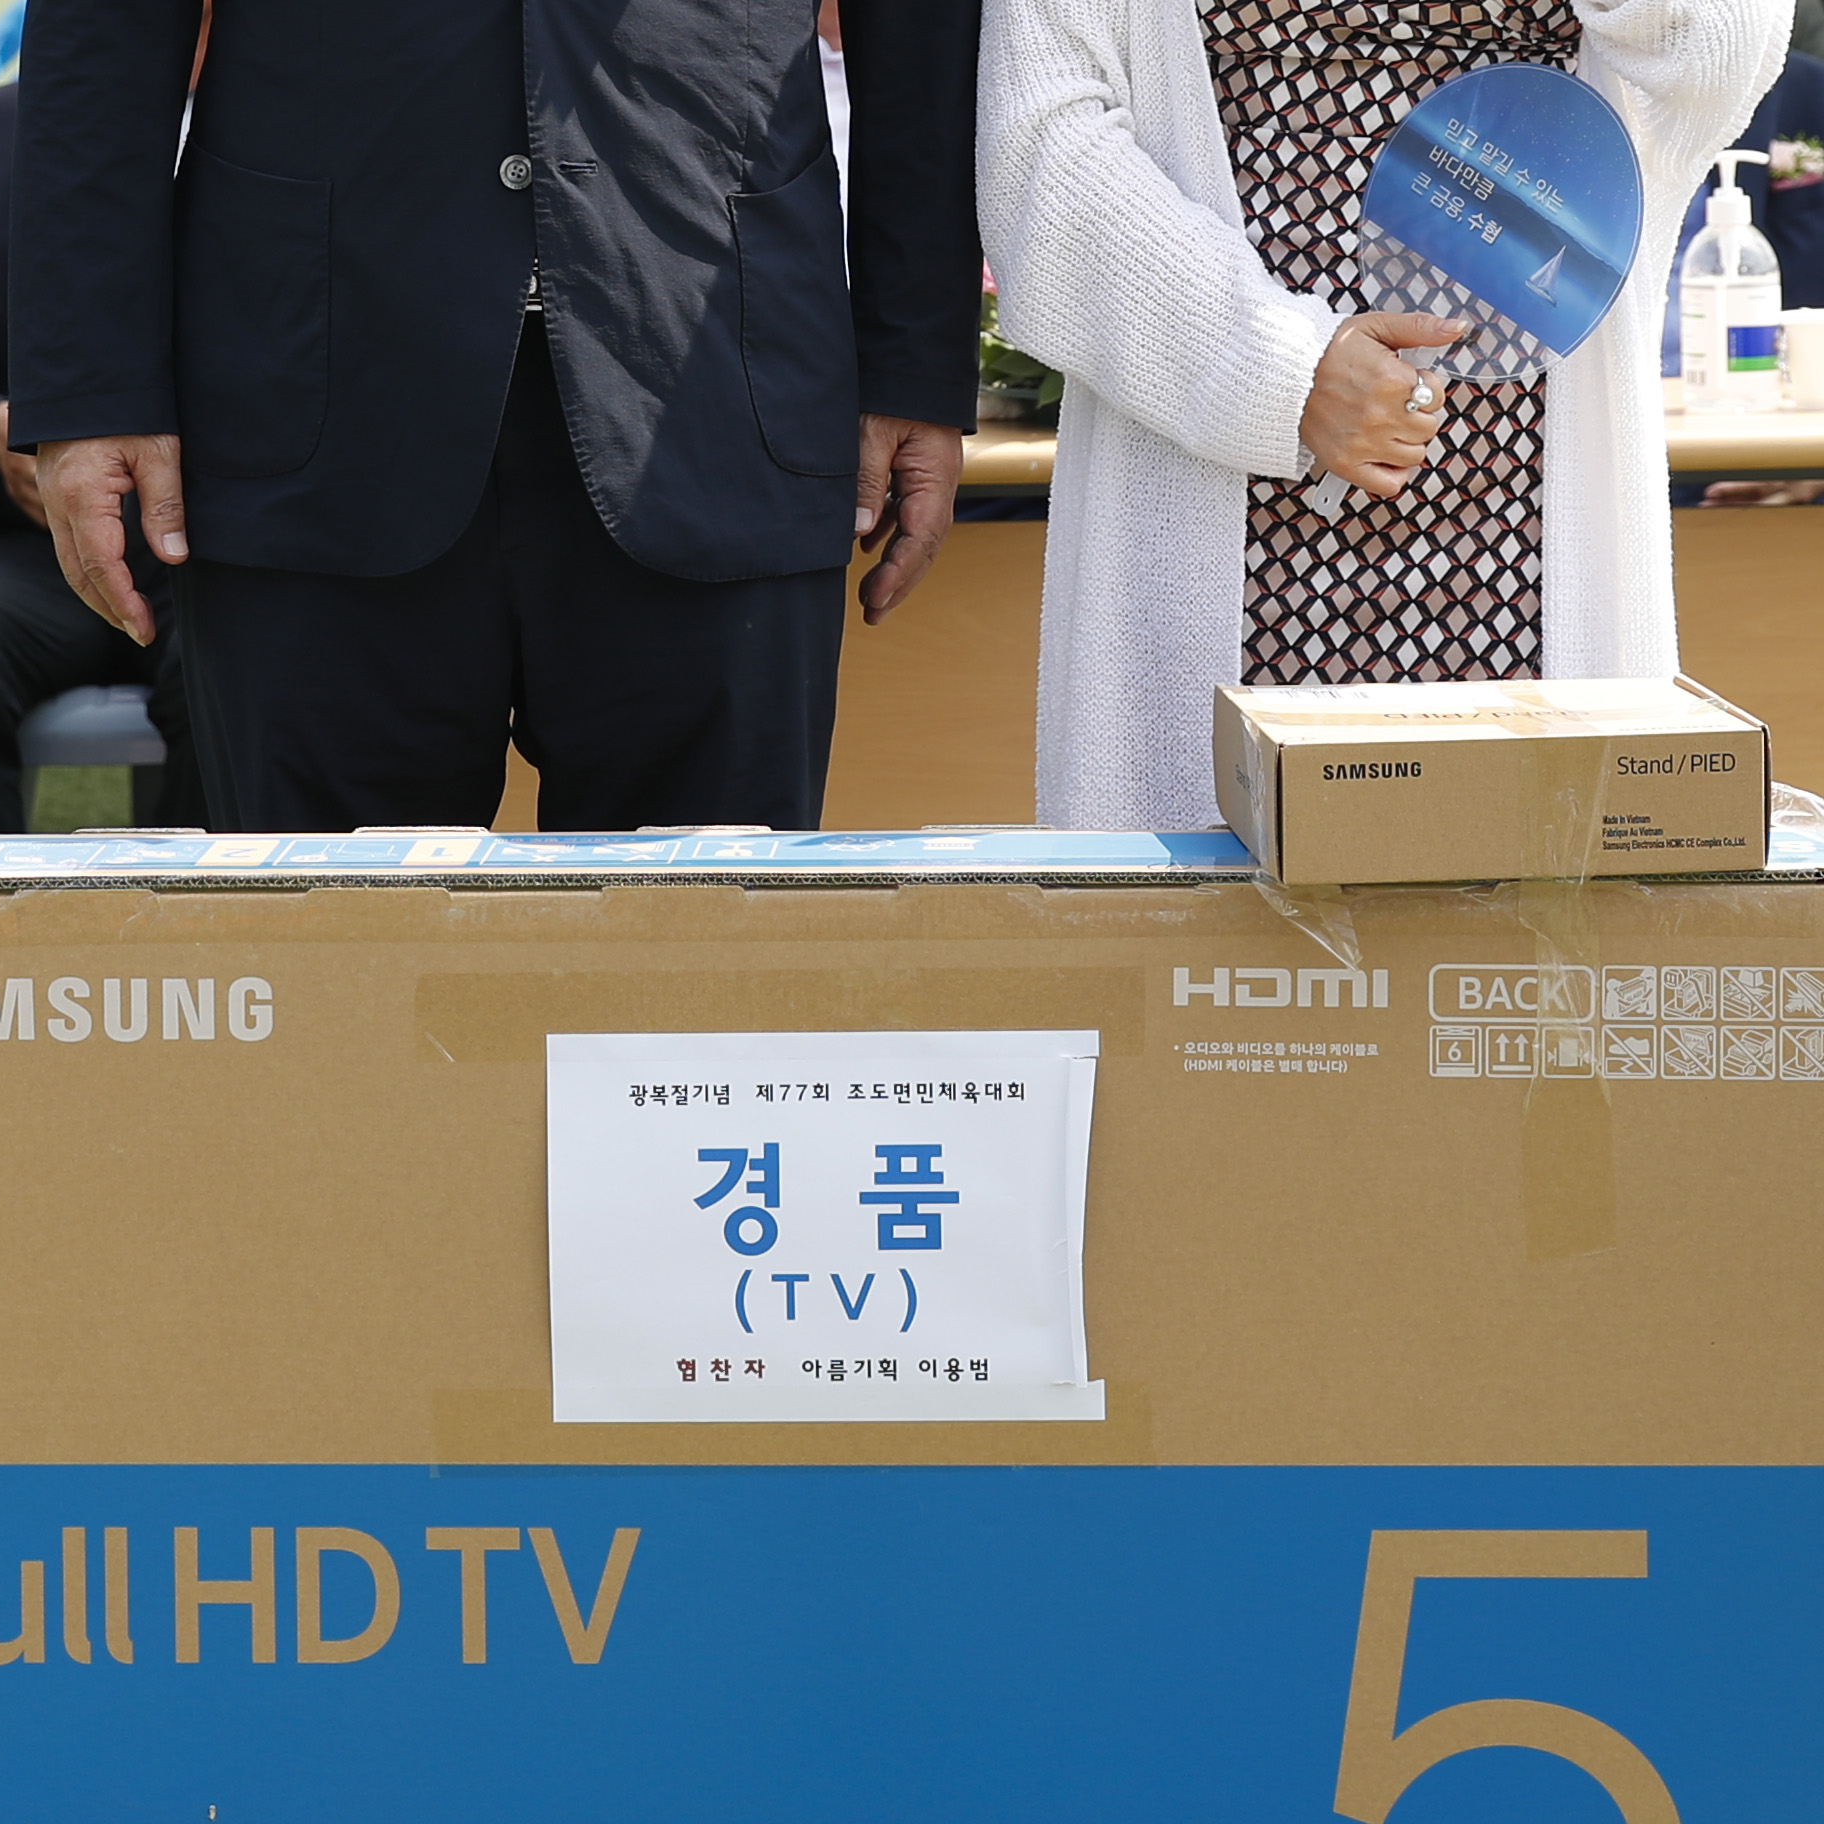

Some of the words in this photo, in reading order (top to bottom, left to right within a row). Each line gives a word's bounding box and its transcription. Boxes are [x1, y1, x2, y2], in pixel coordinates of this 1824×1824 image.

[1428, 144, 1497, 202] 바다만큼
[1444, 117, 1479, 151] 믿고
[1479, 141, 1516, 177] 맡길
[1514, 167, 1533, 189] 수
[1530, 178, 1566, 217] 있는
[1409, 171, 1432, 196] 큰
[1430, 185, 1467, 225] 금융,
[1466, 210, 1505, 246] 수협
[1322, 760, 1423, 782] SAMSUNG
[1616, 753, 1674, 776] Stand
[1689, 752, 1737, 773] PIED
[1602, 815, 1619, 825] Made
[1627, 814, 1652, 824] Vietnam
[1602, 827, 1629, 840] Fabrique
[1630, 827, 1639, 837] Au
[1639, 827, 1664, 837] Vietnam
[1602, 840, 1631, 852] Samsung
[1631, 839, 1666, 850] Electronics
[1666, 838, 1685, 849] HCMC
[1685, 837, 1696, 848] CE
[1696, 837, 1722, 849] Complex
[1172, 965, 1390, 1009] HDMI
[1457, 975, 1566, 1012] BACK
[1183, 1041, 1235, 1056] 오디오와
[1237, 1042, 1287, 1057] 비디오를
[1289, 1042, 1327, 1057] 하나의
[1329, 1043, 1380, 1057] 케이블로
[1183, 1058, 1224, 1073] (HDMI
[1225, 1059, 1276, 1074] 케이블은
[1278, 1059, 1304, 1074] 별매
[1306, 1059, 1349, 1074] 합니다)
[628, 1083, 732, 1108] 광복절기념
[754, 1082, 831, 1103] 제77회
[847, 1080, 1027, 1104] 조도면민체육대회
[800, 1357, 899, 1383] 아름기획
[917, 1356, 990, 1383] 이용범
[172, 1525, 403, 1665] HD
[424, 1525, 643, 1666] TV
